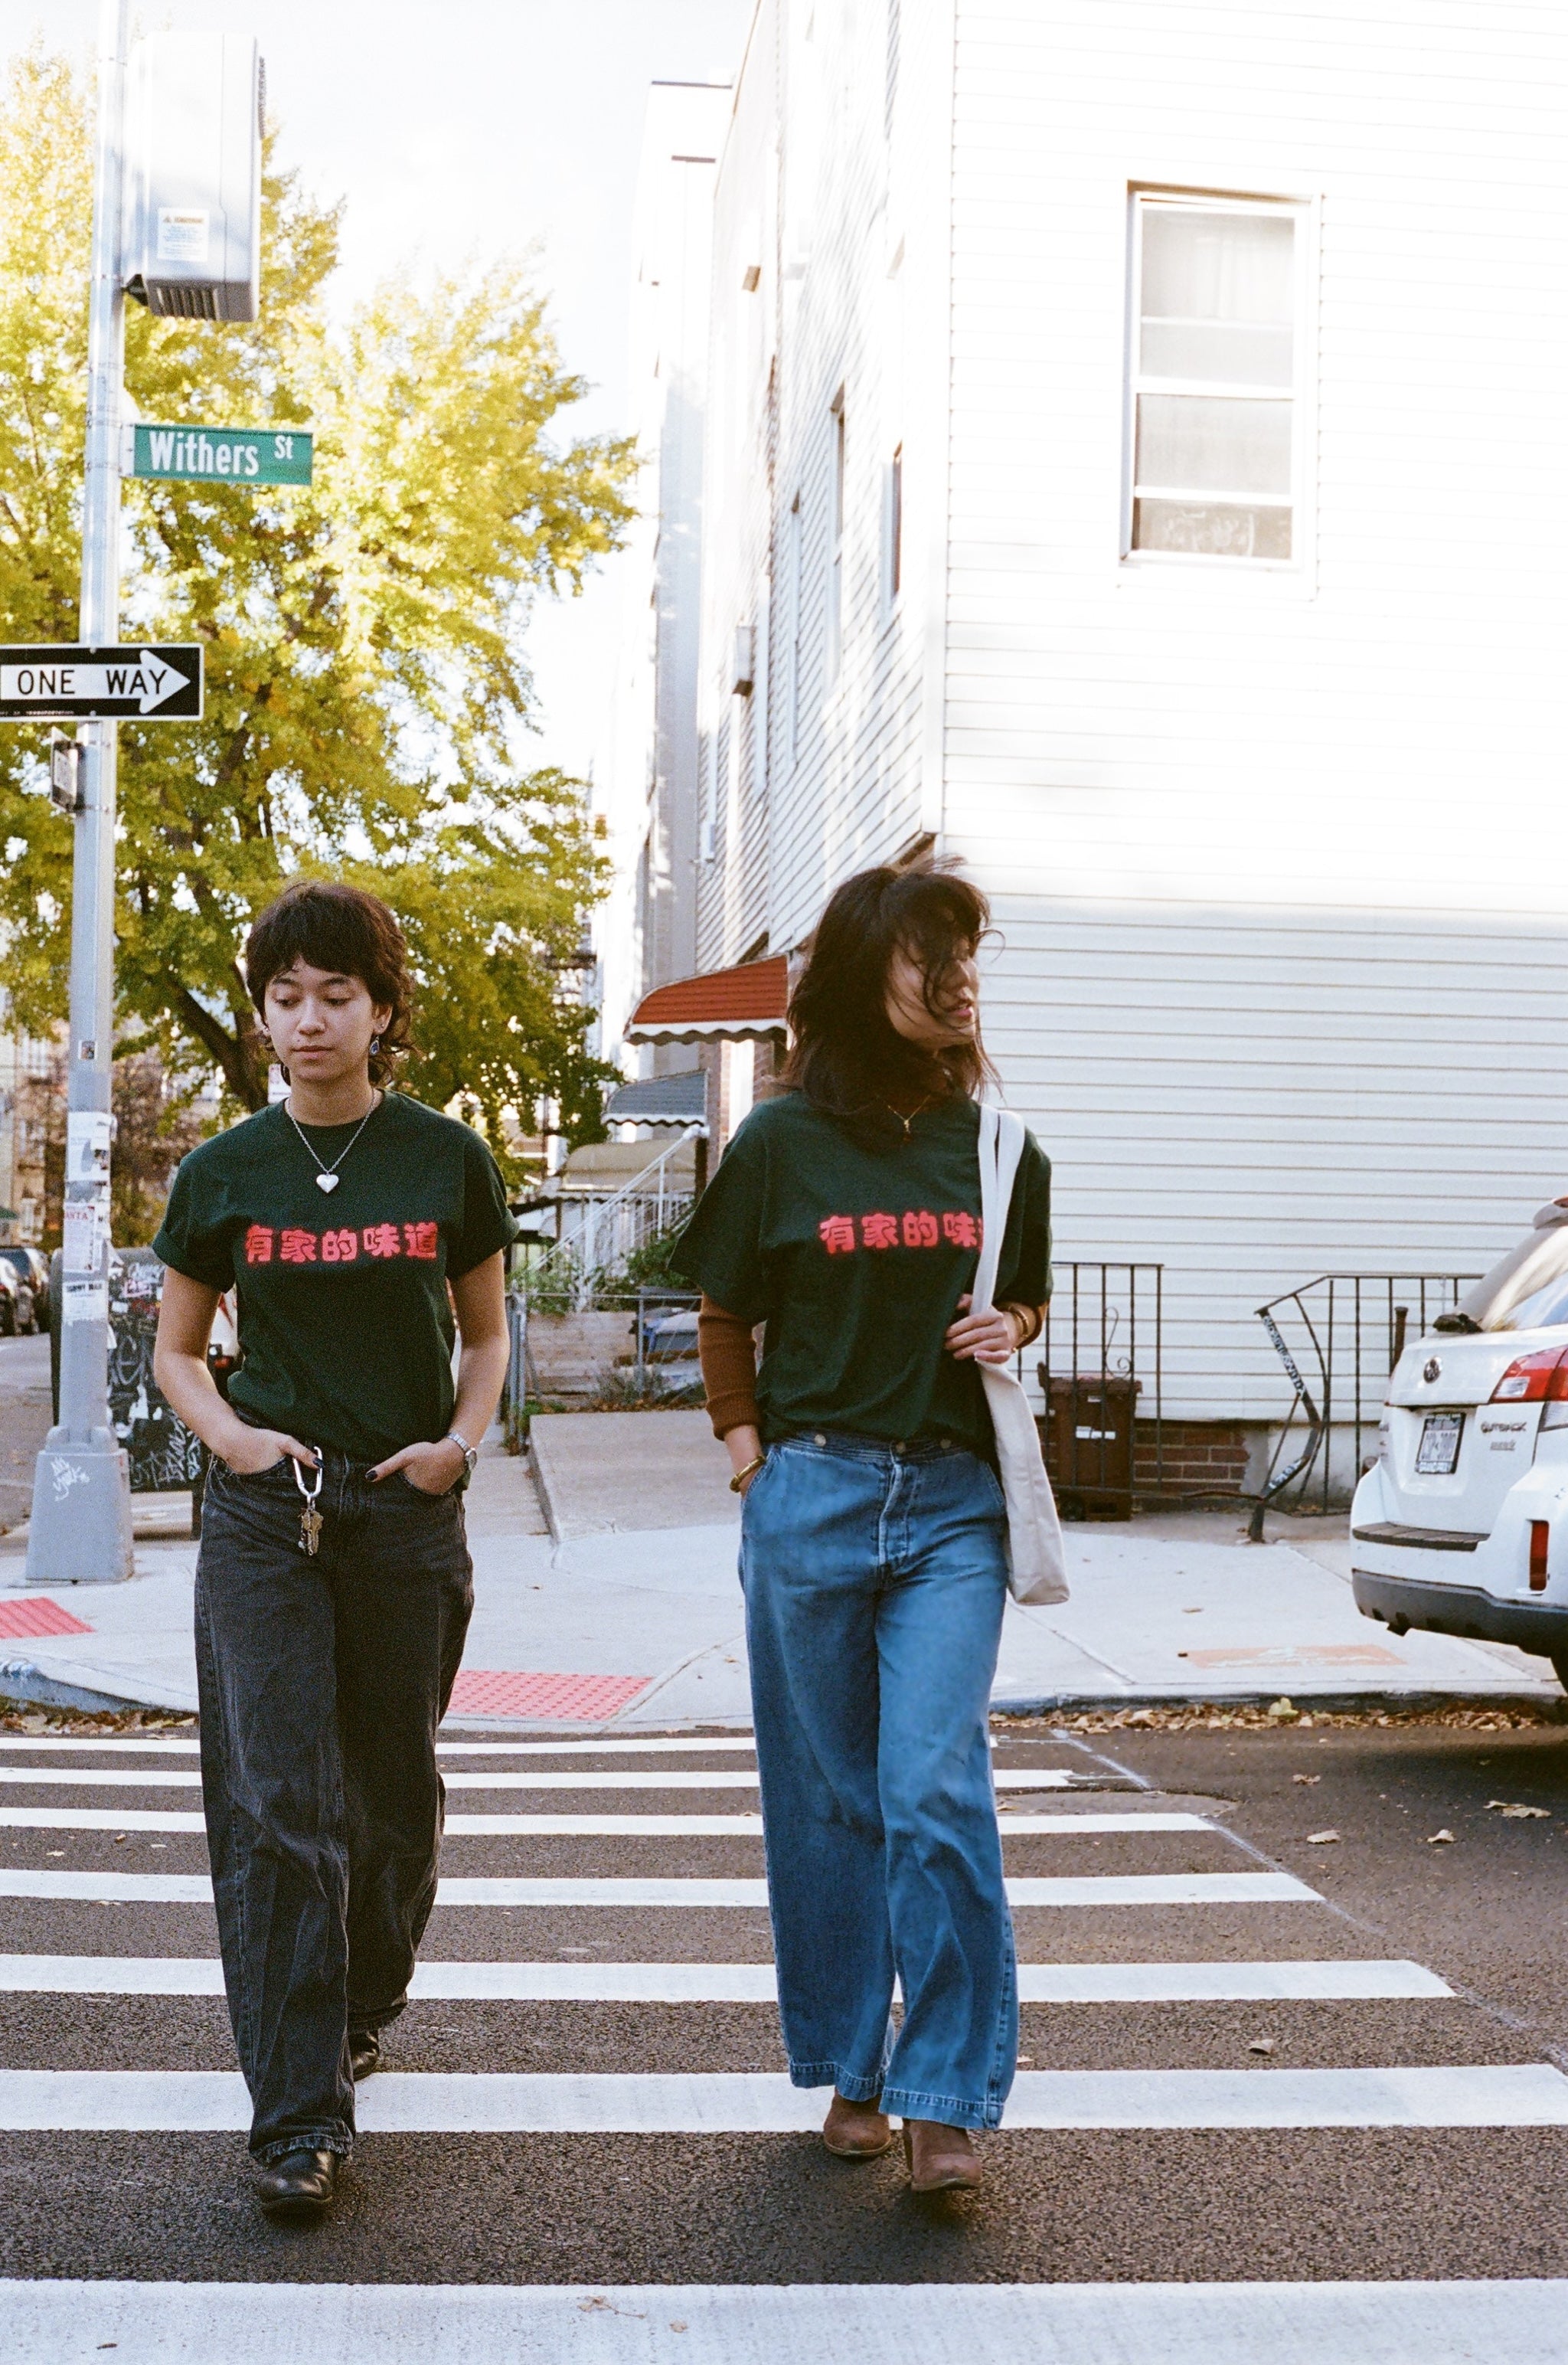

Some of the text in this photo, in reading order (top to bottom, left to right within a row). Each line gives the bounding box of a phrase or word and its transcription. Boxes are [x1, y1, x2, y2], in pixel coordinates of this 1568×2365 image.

[149, 431, 294, 476] Withers St
[18, 669, 168, 695] ONE WAY
[246, 1222, 438, 1264] 有家的味道
[820, 1211, 983, 1254] 有家的味
